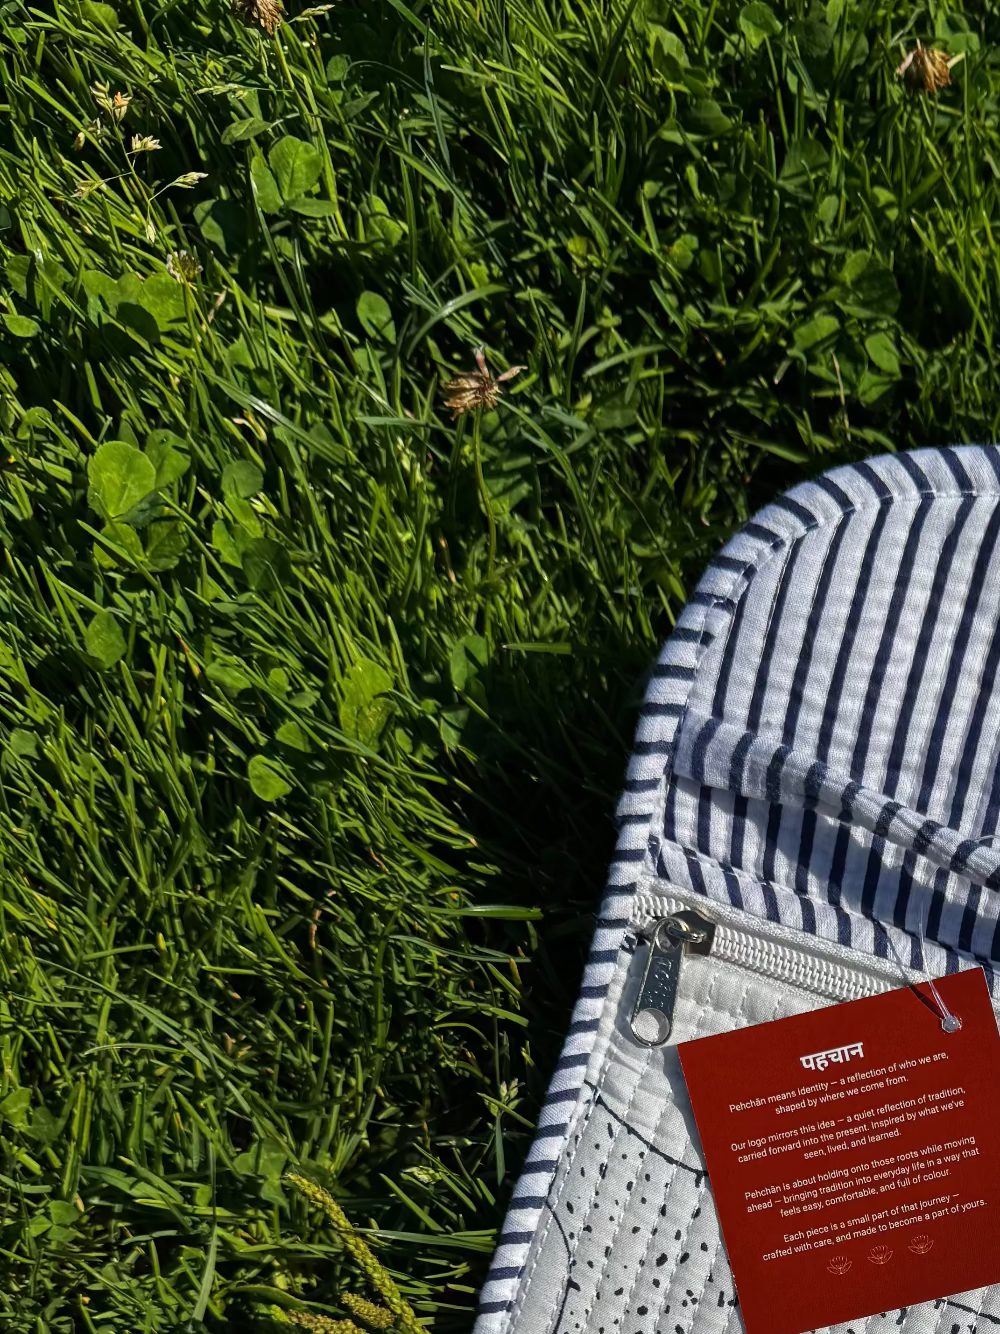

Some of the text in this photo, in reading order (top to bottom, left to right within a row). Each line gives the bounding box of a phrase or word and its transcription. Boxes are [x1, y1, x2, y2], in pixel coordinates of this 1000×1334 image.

[767, 1090, 796, 1104] means
[797, 1082, 828, 1096] identity
[839, 1078, 846, 1086] a
[846, 1067, 886, 1084] reflection
[887, 1062, 897, 1073] of
[898, 1059, 916, 1070] who
[917, 1055, 931, 1065] we
[932, 1052, 948, 1062] are,
[799, 1041, 864, 1072] पहचान
[730, 1142, 745, 1152] Our
[747, 1137, 766, 1148] logo
[767, 1129, 798, 1143] mirrors
[799, 1124, 815, 1135] this
[816, 1120, 835, 1131] idea
[846, 1115, 853, 1123] a
[853, 1108, 875, 1122] quiet
[876, 1099, 916, 1115] reflection
[917, 1093, 927, 1105] of
[927, 1087, 965, 1102] tradition,
[775, 1075, 908, 1115] shaped by where we come from.
[737, 1148, 767, 1163] carried
[768, 1139, 801, 1156] forward
[802, 1137, 819, 1147] into
[819, 1133, 834, 1143] the
[835, 1123, 869, 1140] present.
[870, 1113, 905, 1130] Inspired
[905, 1111, 917, 1121] by
[917, 1105, 939, 1117] what
[803, 1127, 901, 1160] seen, lived, and learned.
[746, 1198, 772, 1213] ahead
[782, 1189, 817, 1204] bringing
[818, 1180, 854, 1195] tradition
[855, 1175, 871, 1186] into
[873, 1165, 909, 1181] everyday
[911, 1161, 925, 1172] life
[926, 1159, 935, 1168] in
[936, 1157, 943, 1165] a
[943, 1153, 960, 1163] way
[961, 1147, 979, 1159] that
[782, 1182, 791, 1191] is
[792, 1175, 816, 1189] about
[817, 1168, 849, 1182] holding
[850, 1163, 869, 1174] onto
[870, 1157, 895, 1169] those
[896, 1150, 918, 1162] roots
[919, 1144, 942, 1156] while
[943, 1136, 975, 1150] moving
[779, 1168, 951, 1218] feels easy, comfortable, and full of colour.
[783, 1230, 804, 1243] Each
[805, 1225, 828, 1239] piece
[829, 1222, 839, 1231] is
[839, 1221, 846, 1229] a
[846, 1213, 870, 1227] small
[871, 1209, 889, 1223] part
[890, 1205, 899, 1216] of
[900, 1202, 918, 1213] that
[919, 1194, 950, 1211] journey
[762, 1199, 987, 1261] crafted with care, and made to become a part of yours.
